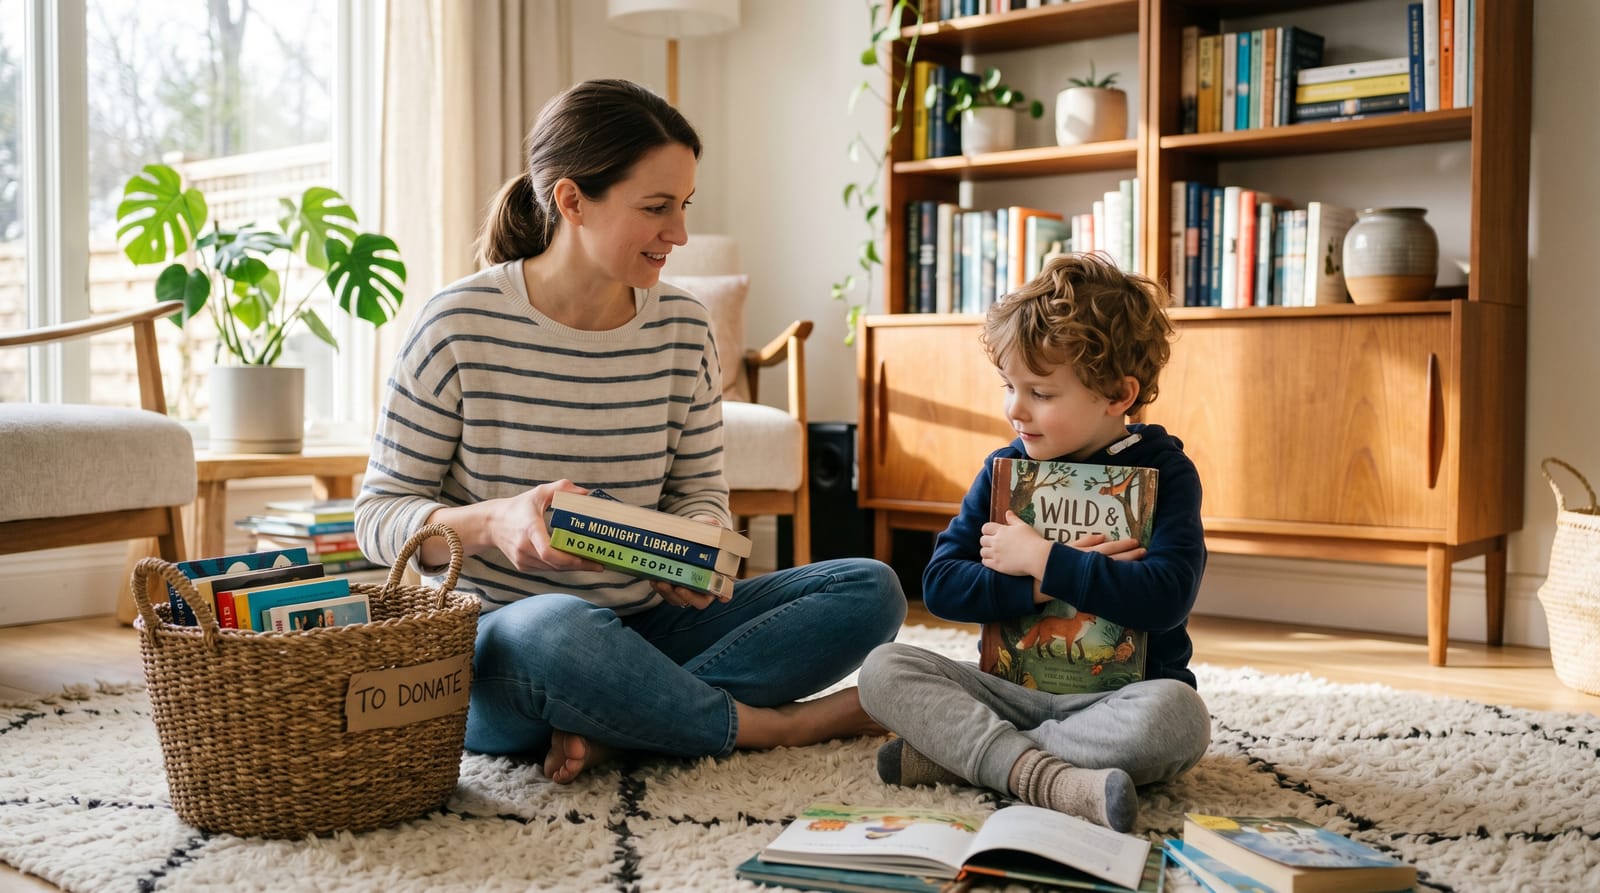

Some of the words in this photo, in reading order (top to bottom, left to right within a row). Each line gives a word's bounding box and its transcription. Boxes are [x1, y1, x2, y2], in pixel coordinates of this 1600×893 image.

[1040, 496, 1100, 527] WILD
[1105, 507, 1120, 527] &
[570, 516, 585, 530] The
[588, 521, 641, 544] MIDNIGHT
[643, 535, 690, 557] LIBRARY
[566, 537, 624, 561] NORMAL
[631, 555, 684, 577] PEOPLE
[355, 686, 386, 713] TO
[398, 669, 463, 707] DONATE
